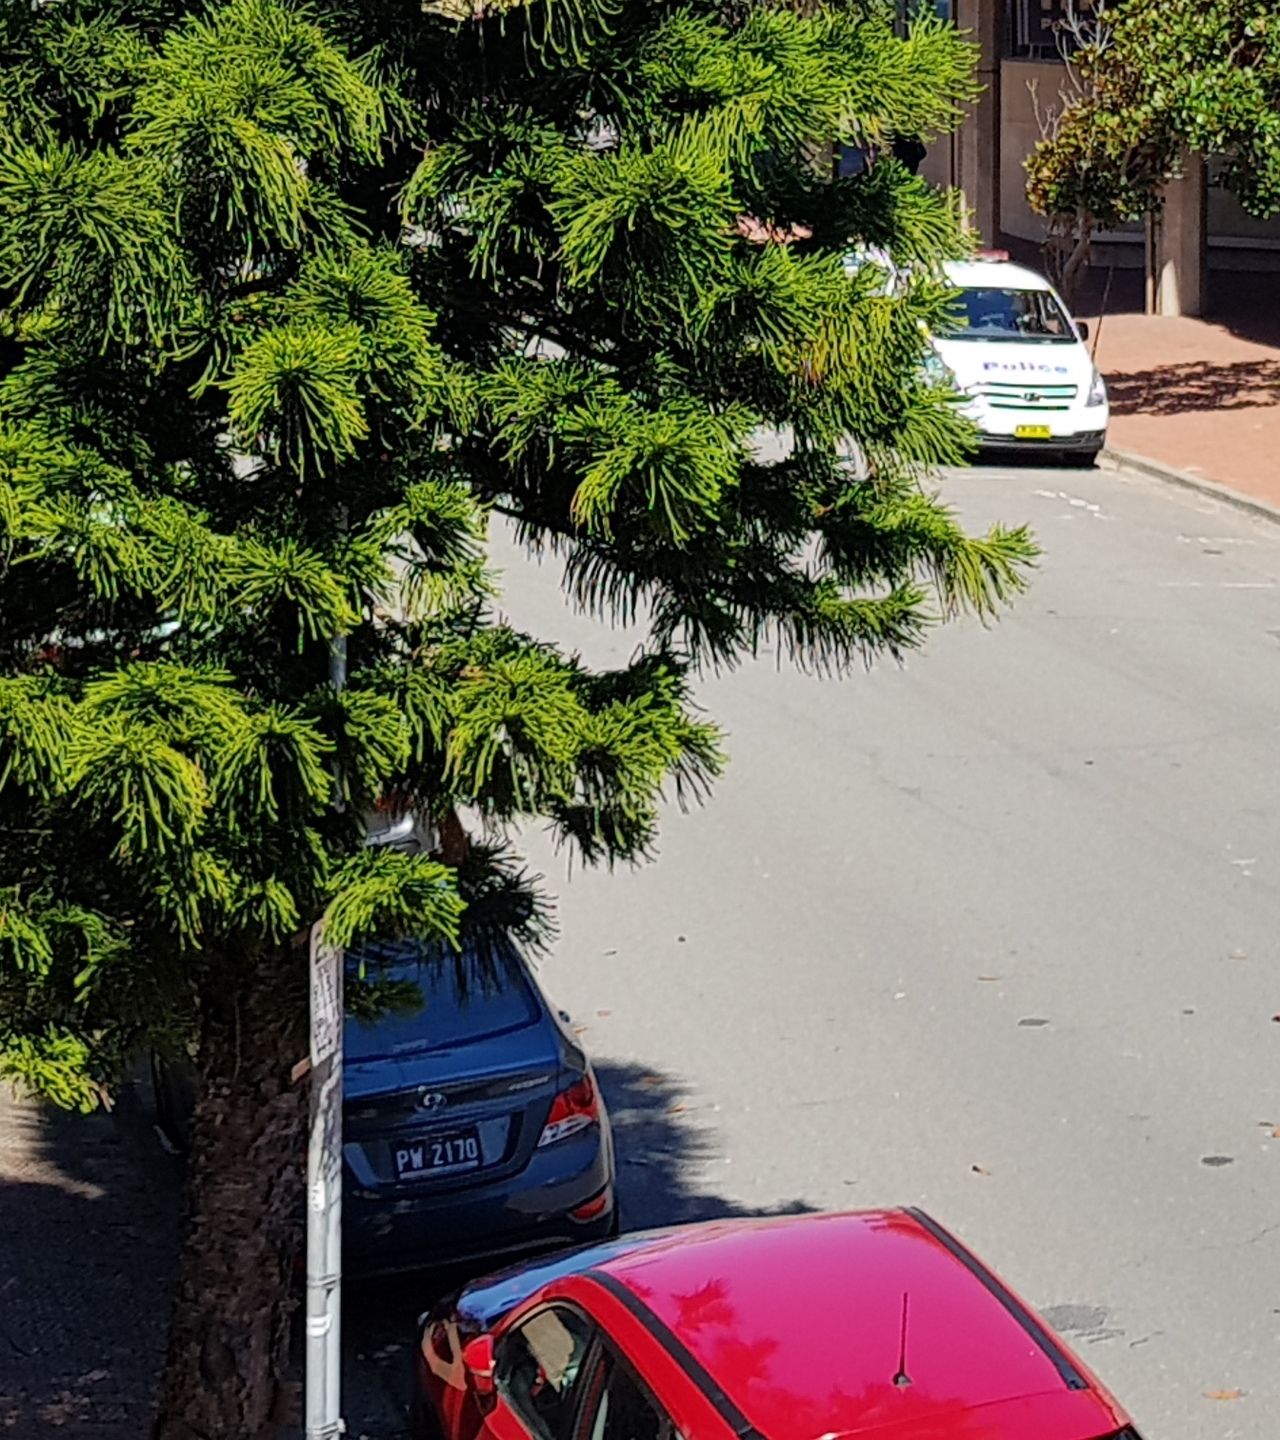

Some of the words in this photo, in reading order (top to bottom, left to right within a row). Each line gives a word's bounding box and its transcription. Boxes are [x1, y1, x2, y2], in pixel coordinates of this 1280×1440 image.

[982, 361, 1069, 375] Police
[396, 1147, 424, 1172] PW
[433, 1138, 479, 1166] 2170
